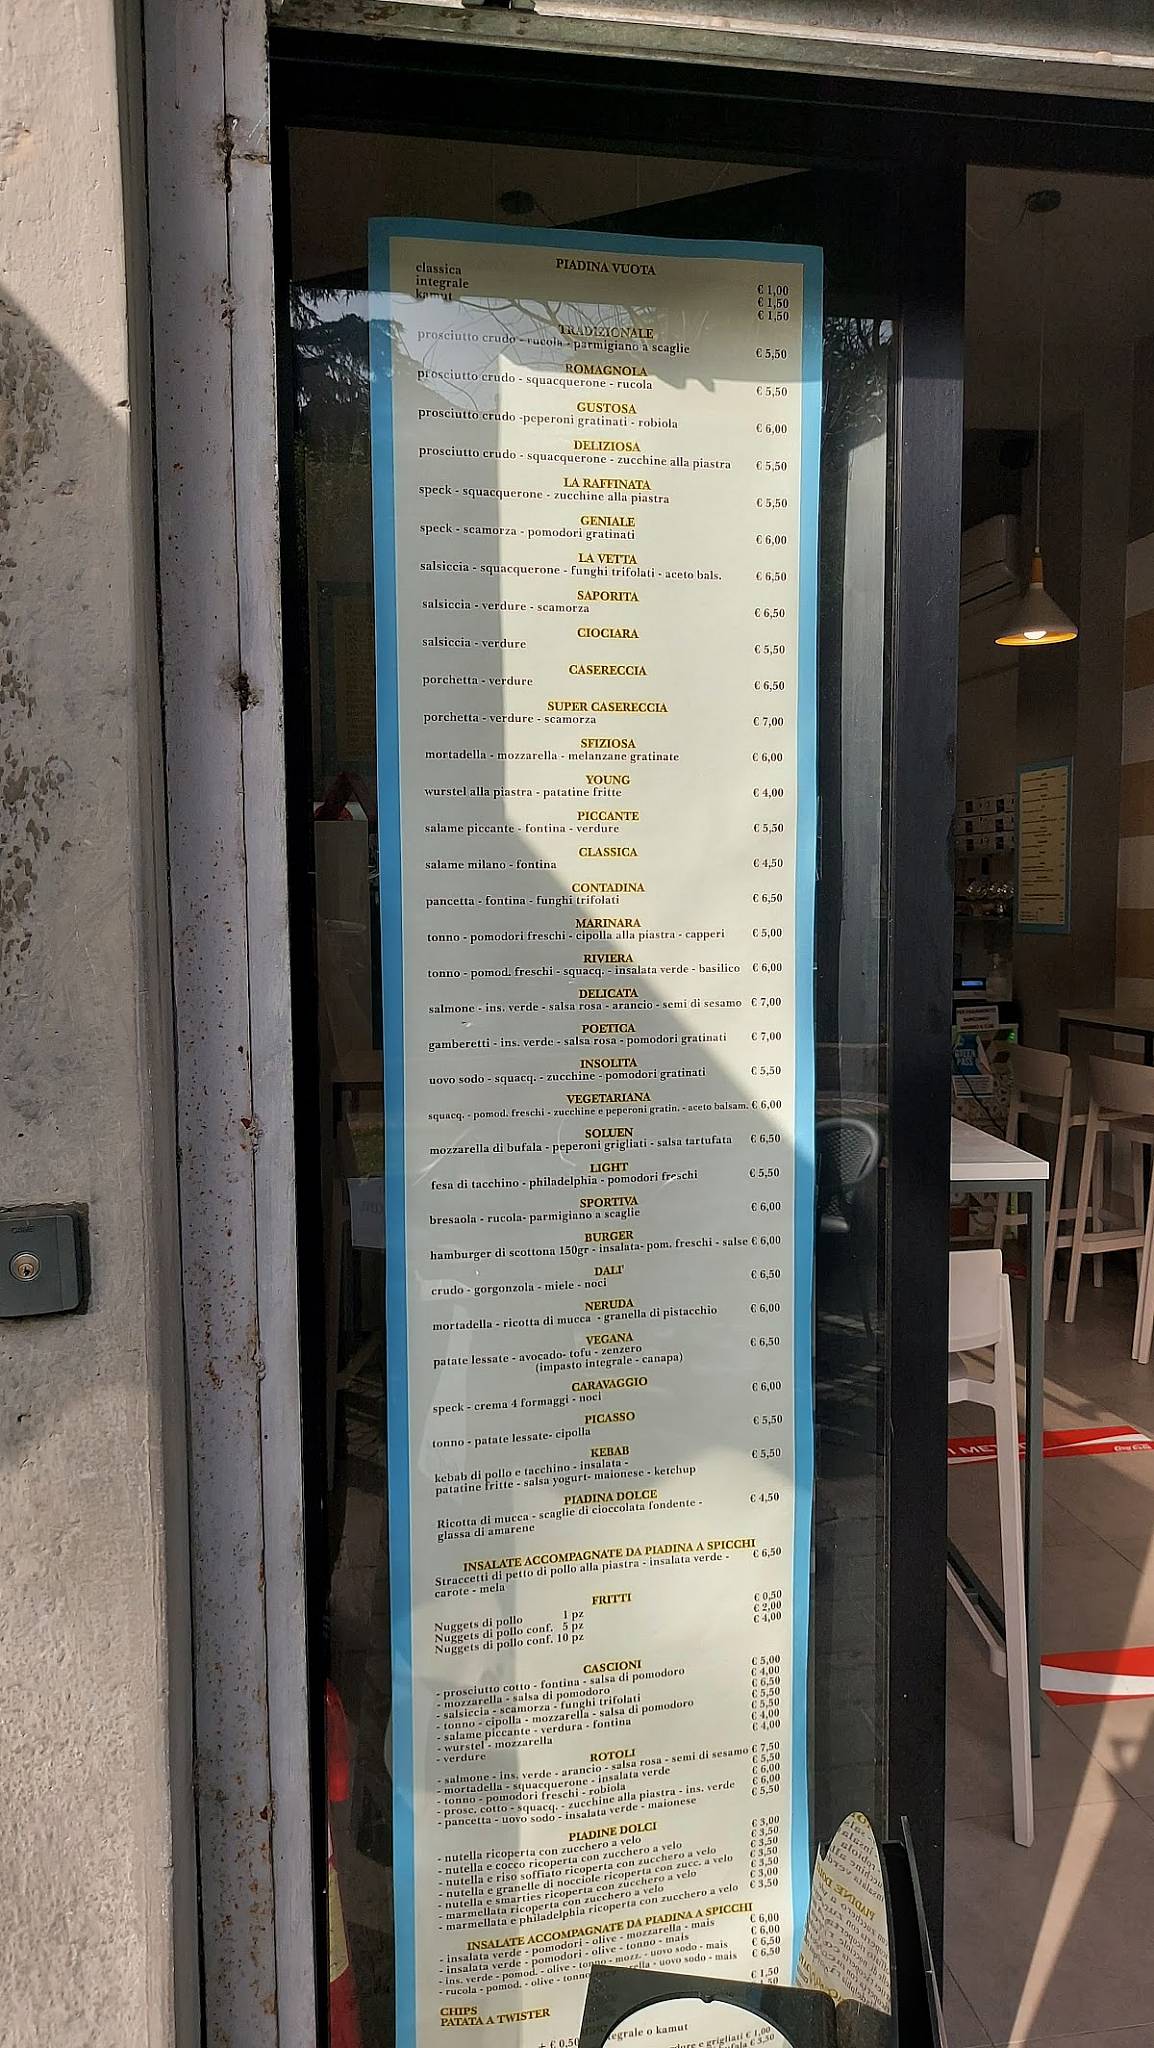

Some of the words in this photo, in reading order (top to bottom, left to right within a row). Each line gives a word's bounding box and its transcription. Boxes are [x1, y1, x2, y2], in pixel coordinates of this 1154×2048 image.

[416, 262, 462, 275] classica
[555, 258, 609, 273] PIADINA
[612, 262, 656, 276] VUOTA
[416, 276, 469, 290] integrale
[558, 324, 654, 340] TRADIZIONALE
[417, 329, 479, 343] prosciutto
[482, 333, 516, 344] crudo
[573, 340, 639, 355] parmigiano
[652, 343, 690, 356] scaglie
[565, 363, 648, 376] ROMAGNOLA
[526, 377, 606, 389] squacquerone
[617, 379, 652, 389] rucola
[577, 402, 637, 414] GUSTOSA
[578, 415, 627, 428] gratinati
[639, 418, 678, 429] robiola
[574, 440, 641, 452] DELIZIOSA
[419, 446, 479, 458] prosciutto
[480, 449, 516, 459] crudo
[527, 453, 607, 465] squacquerone
[618, 455, 667, 466] zucchine
[670, 457, 689, 467] alla
[693, 458, 731, 471] piastra
[563, 477, 581, 488] LA
[582, 478, 652, 490] RAFFINATA
[580, 515, 635, 527] GENIALE
[578, 553, 595, 563] LA
[597, 553, 638, 565] VETTA
[420, 561, 469, 572] salsiccia
[480, 565, 560, 576] squacquerone
[571, 565, 608, 579] funghi
[612, 566, 655, 578] trifolati
[665, 571, 694, 579] aceto
[697, 570, 722, 580] bals.
[577, 590, 639, 602] SAPORITA
[577, 628, 639, 639] CIOCIARA
[569, 664, 647, 676] CASERECCIA
[547, 701, 589, 712] SUPER
[591, 701, 668, 713] CASERECCIA
[581, 738, 636, 749] SFIZIOSA
[425, 749, 486, 759] mortadella
[497, 750, 557, 760] mozzarella
[568, 751, 627, 760] melanzane
[630, 751, 679, 764] gratinate
[586, 775, 630, 785] YOUNG
[577, 811, 639, 821] PICCANTE
[425, 823, 464, 833] salame
[467, 823, 514, 836] piccante
[525, 823, 566, 833] fontina
[576, 823, 619, 833] verdure
[579, 847, 638, 857] CLASSICA
[572, 883, 645, 893] CONTADINA
[575, 917, 642, 929] MARINARA
[427, 934, 460, 942] tonno
[470, 931, 527, 944] pomodori
[527, 930, 565, 940] freschi
[576, 929, 612, 943] cipolla
[616, 930, 635, 939] alla
[638, 929, 675, 942] piastra
[685, 929, 724, 941] capperi
[583, 953, 634, 964] RIVIERA
[578, 988, 639, 999] DELICATA
[429, 1004, 475, 1014] salmone
[612, 999, 653, 1010] arancio
[662, 999, 687, 1008] semi
[690, 998, 700, 1008] di
[581, 1023, 637, 1034] POETICA
[580, 1057, 638, 1071] INSOLITA
[566, 1092, 652, 1104] VEGETARIANA
[585, 1127, 634, 1139] SOLUEN
[429, 1144, 492, 1155] mozzarella
[492, 1142, 506, 1153] di
[506, 1142, 542, 1152] bufala
[550, 1139, 601, 1154] peperoni
[601, 1138, 647, 1152] grigliati
[657, 1137, 682, 1147] salsa
[685, 1135, 732, 1145] tartufata
[589, 1162, 629, 1175] LIGHT
[469, 1178, 519, 1189] tacchino
[529, 1174, 601, 1190] philadelphia
[579, 1196, 639, 1208] SPORTIVA
[584, 1230, 634, 1243] BURGER
[430, 1250, 492, 1262] hamburger
[509, 1248, 557, 1257] scottona
[558, 1245, 589, 1257] 150gr
[722, 1237, 748, 1246] salse
[431, 1285, 464, 1296] crudo
[474, 1282, 534, 1297] gorgonzola
[544, 1280, 574, 1291] miele
[584, 1277, 607, 1288] noci
[585, 1298, 635, 1312] NERUDA
[503, 1318, 540, 1328] ricotta
[603, 1308, 647, 1324] granella
[663, 1305, 717, 1320] pistacchio
[585, 1332, 634, 1346] VEGANA
[571, 1376, 648, 1392] CARAVAGGIO
[521, 1394, 569, 1408] formaggi
[585, 1411, 635, 1425] PICASSO
[590, 1446, 629, 1458] KEBAB
[654, 1464, 696, 1476] ketchup
[564, 1492, 614, 1506] PIADINA
[616, 1489, 657, 1502] DOLCE
[590, 1502, 645, 1515] cioccolata
[649, 1499, 696, 1510] fondente
[485, 1523, 535, 1536] amarene
[463, 1557, 522, 1572] INSALATE
[523, 1548, 623, 1566] ACCOMPAGNATE
[625, 1547, 642, 1557] DA
[645, 1542, 693, 1555] PIADINA
[696, 1542, 704, 1551] A
[707, 1538, 755, 1550] SPICCHI
[435, 1571, 489, 1587] Straccetti
[592, 1593, 631, 1605] FRITTI
[434, 1621, 479, 1633] Nuggets
[583, 1660, 641, 1674] CASCIONI
[503, 1683, 530, 1692] cotto
[541, 1678, 580, 1689] fontina
[590, 1748, 635, 1762] ROTOLI
[648, 1798, 696, 1809] maionese
[568, 1827, 617, 1842] PIADINE
[619, 1822, 657, 1835] DOLCI
[445, 1850, 483, 1863] nutella
[486, 1848, 536, 1861] ricoperta
[467, 1936, 525, 1951] INSALATE
[528, 1921, 624, 1944] ACCOMPAGNATE
[627, 1918, 642, 1929] DA
[645, 1911, 694, 1926] PIADINA
[695, 1909, 704, 1918] A
[705, 1902, 752, 1917] SPICCHI
[440, 2006, 477, 2017] CHIPS
[440, 2016, 483, 2027] PATATA
[486, 2016, 494, 2025] A
[496, 2008, 550, 2024] TWISTER
[656, 2024, 688, 2035] kamut
